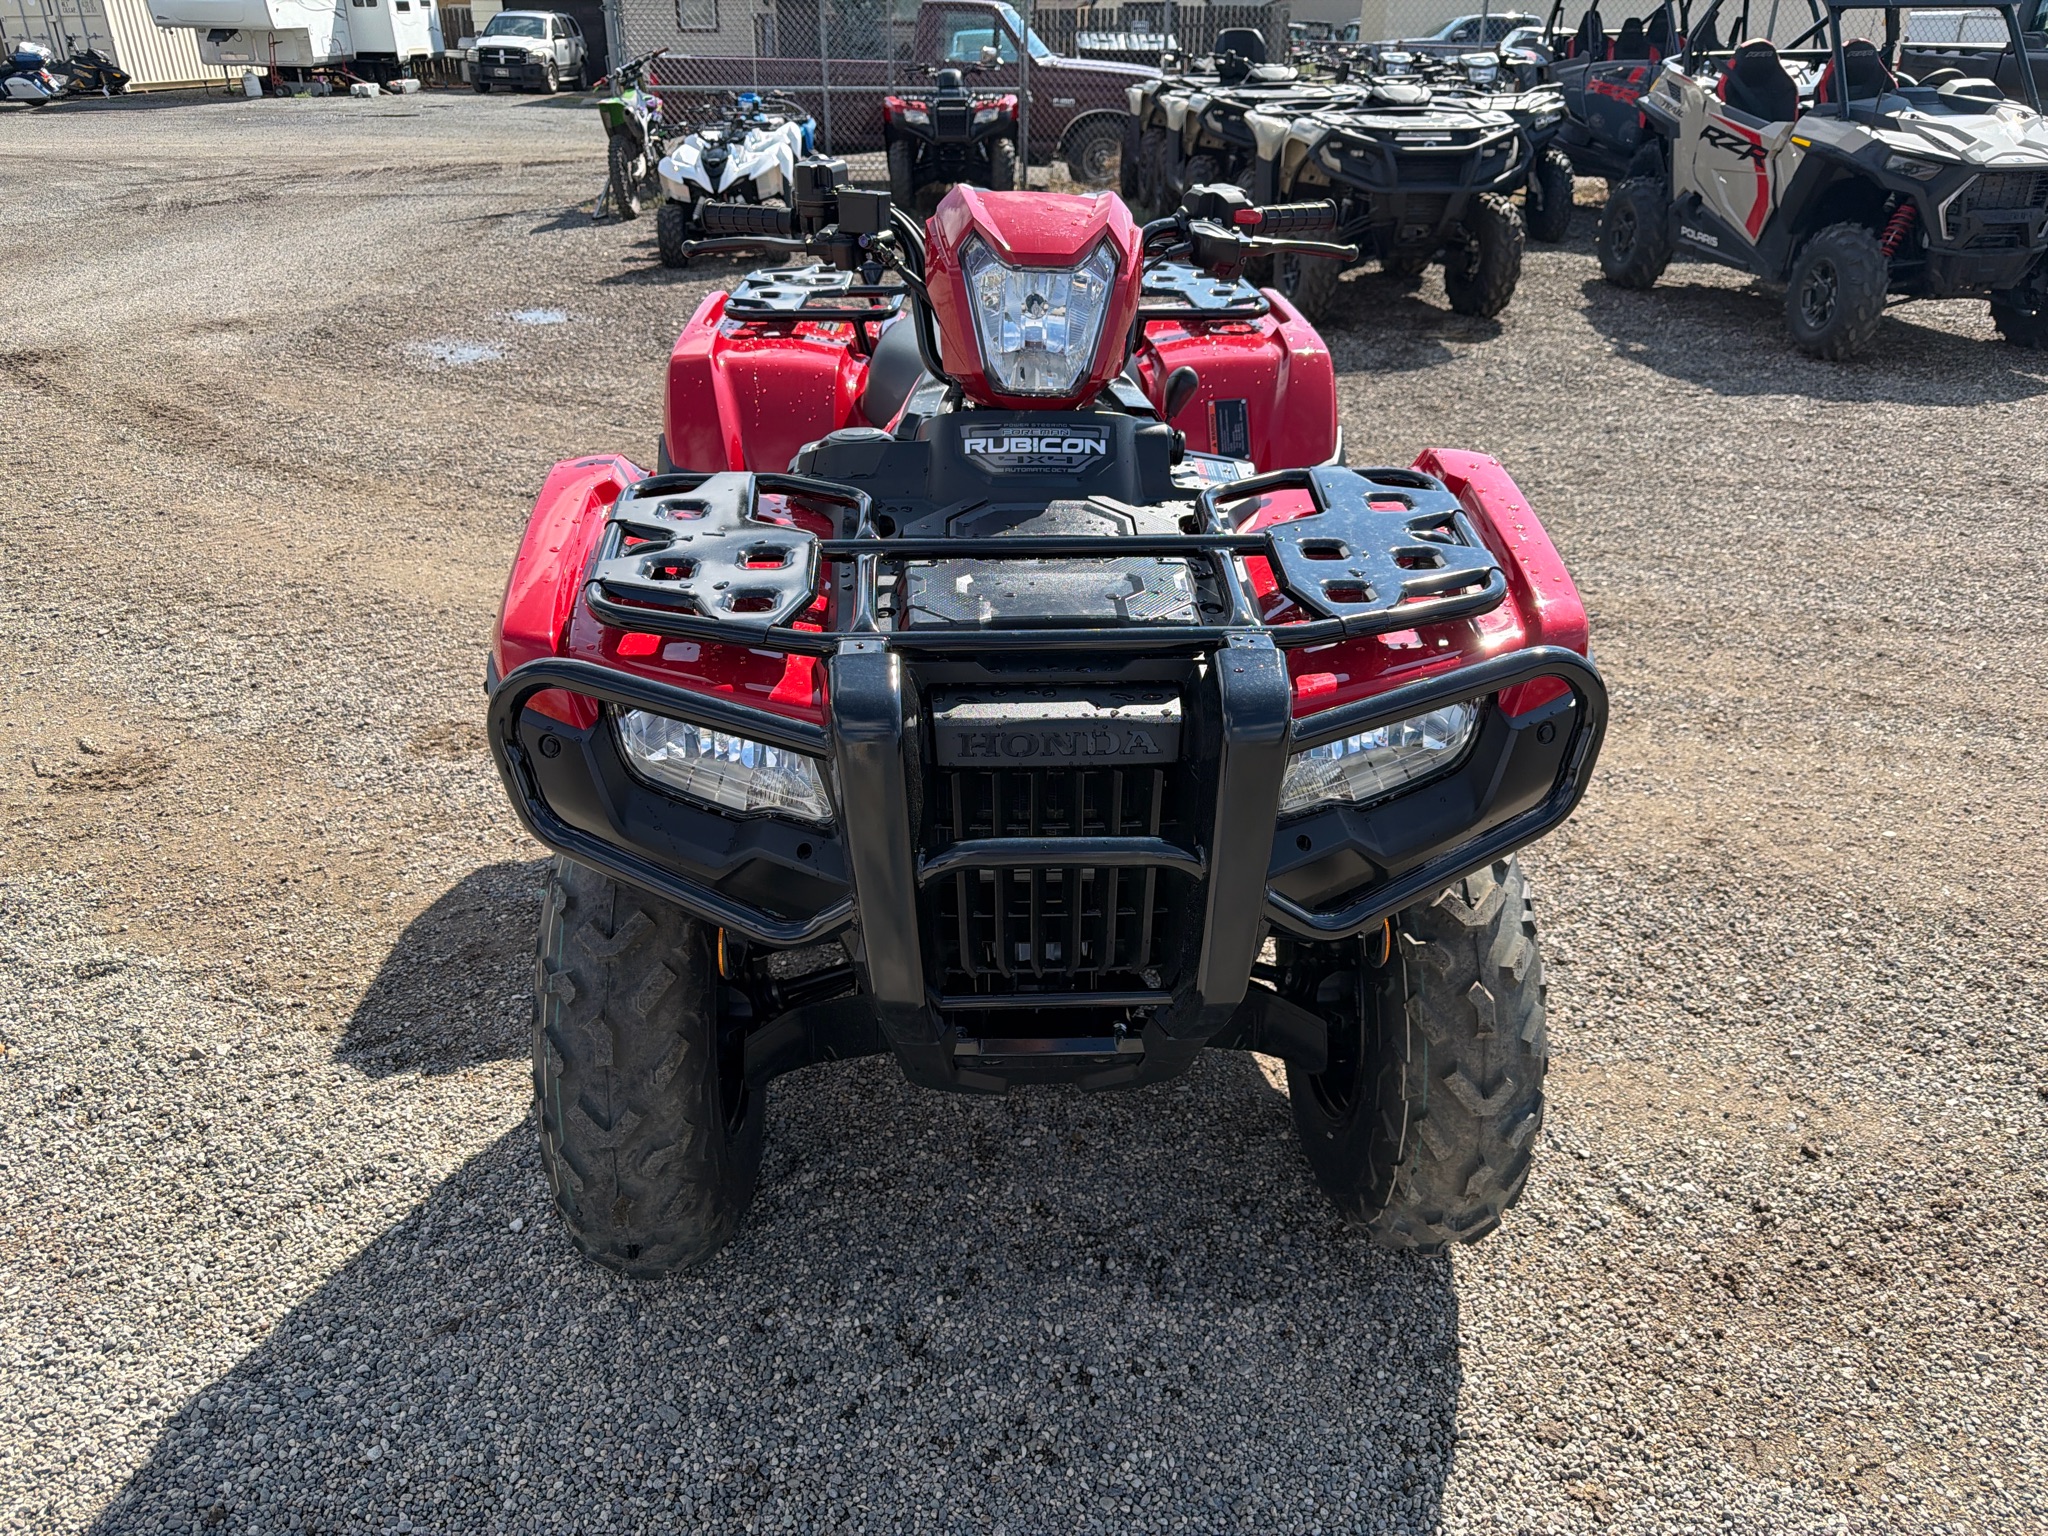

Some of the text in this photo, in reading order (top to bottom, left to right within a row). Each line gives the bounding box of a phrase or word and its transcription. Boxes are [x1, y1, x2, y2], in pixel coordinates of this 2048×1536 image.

[1660, 101, 1684, 119] TRAIL
[1700, 124, 1769, 169] RZR
[1680, 225, 1719, 248] POLARIS
[1001, 428, 1072, 437] FOREMAN
[964, 437, 1106, 455] RUBICON
[957, 730, 1163, 759] HONDA
